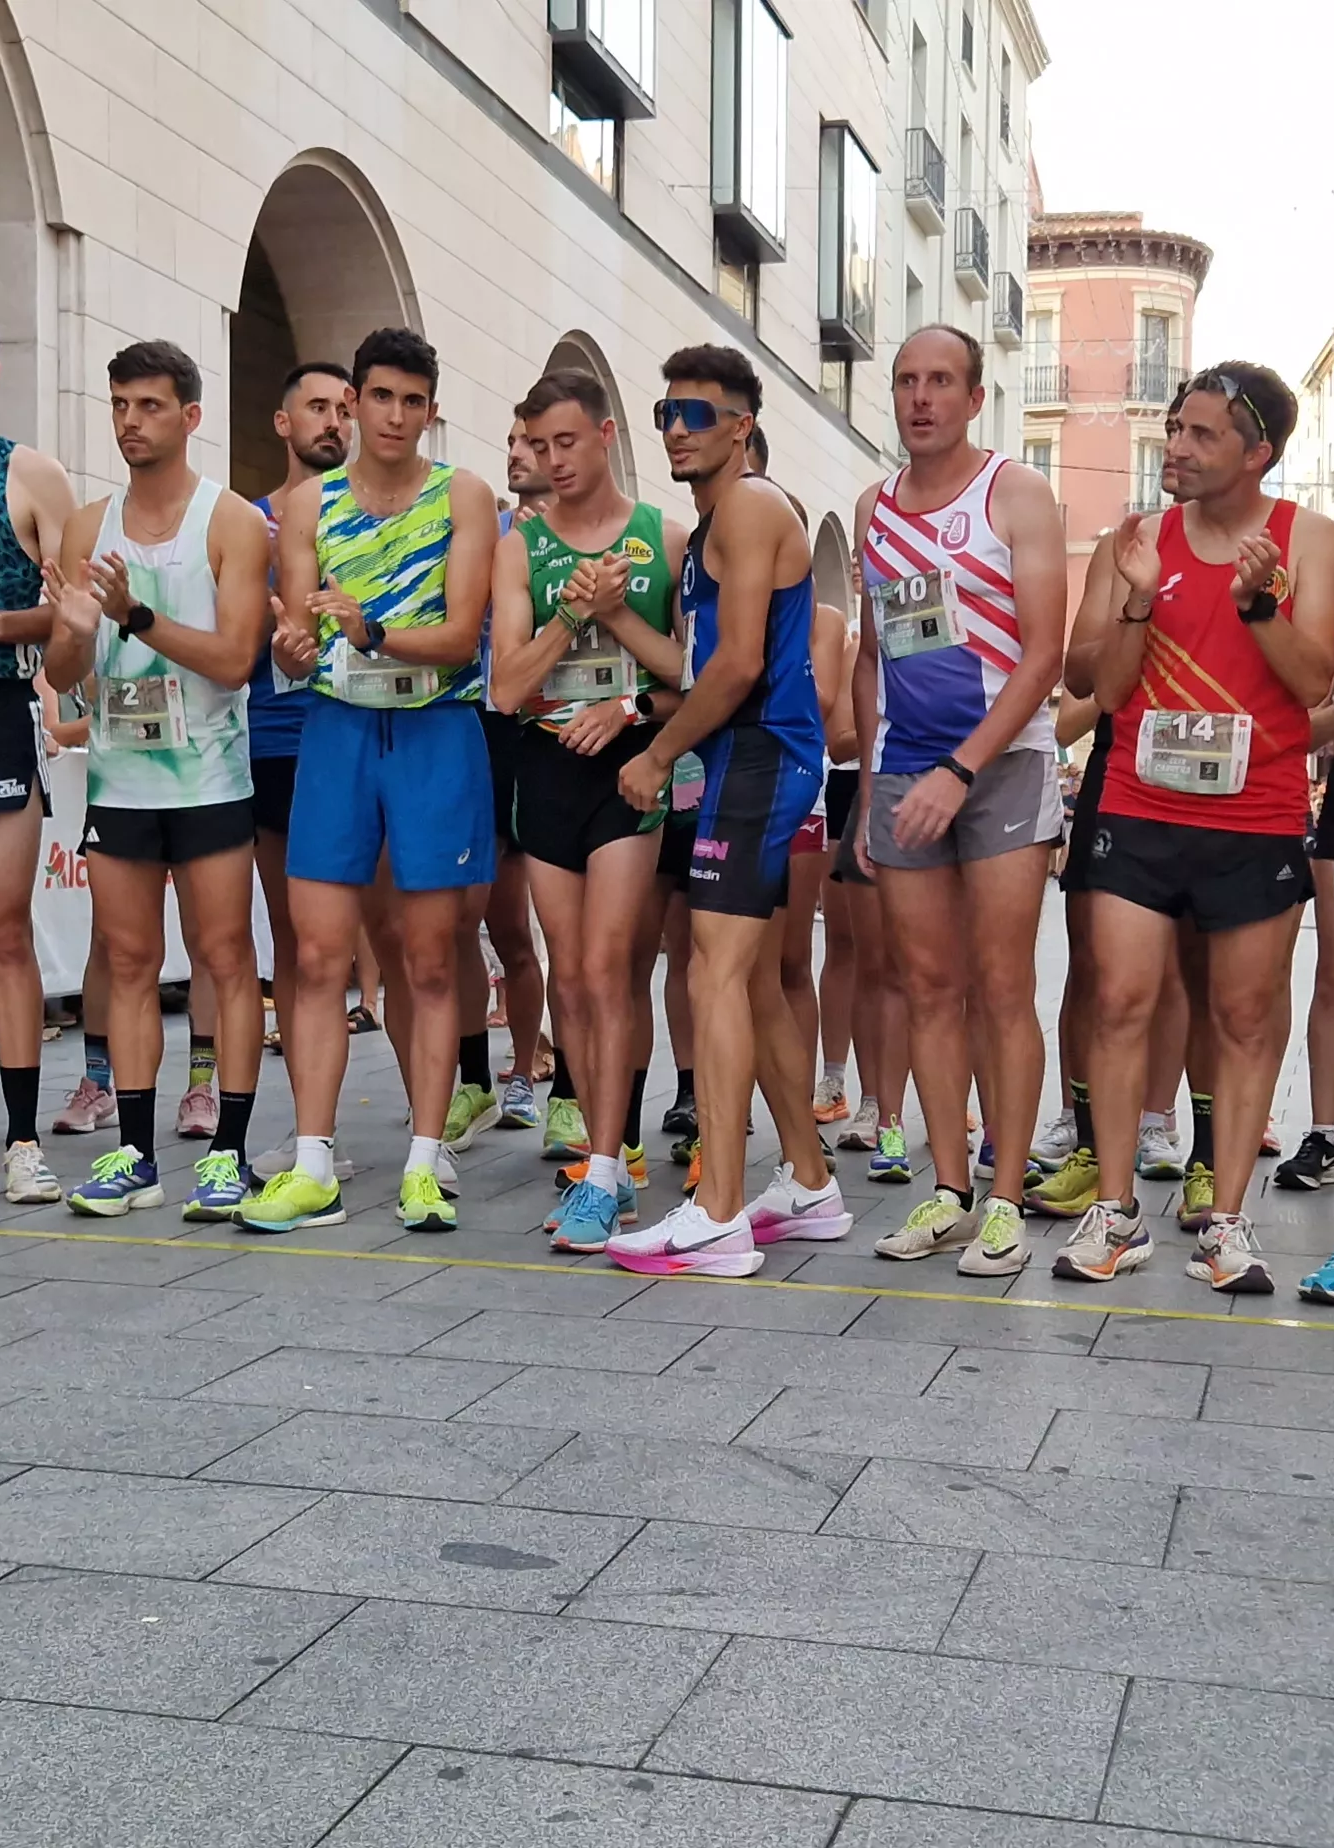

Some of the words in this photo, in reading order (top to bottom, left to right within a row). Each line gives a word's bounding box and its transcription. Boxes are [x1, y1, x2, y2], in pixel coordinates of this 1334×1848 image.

[894, 576, 927, 605] 10
[121, 682, 139, 706] 2
[1172, 713, 1215, 741] 14
